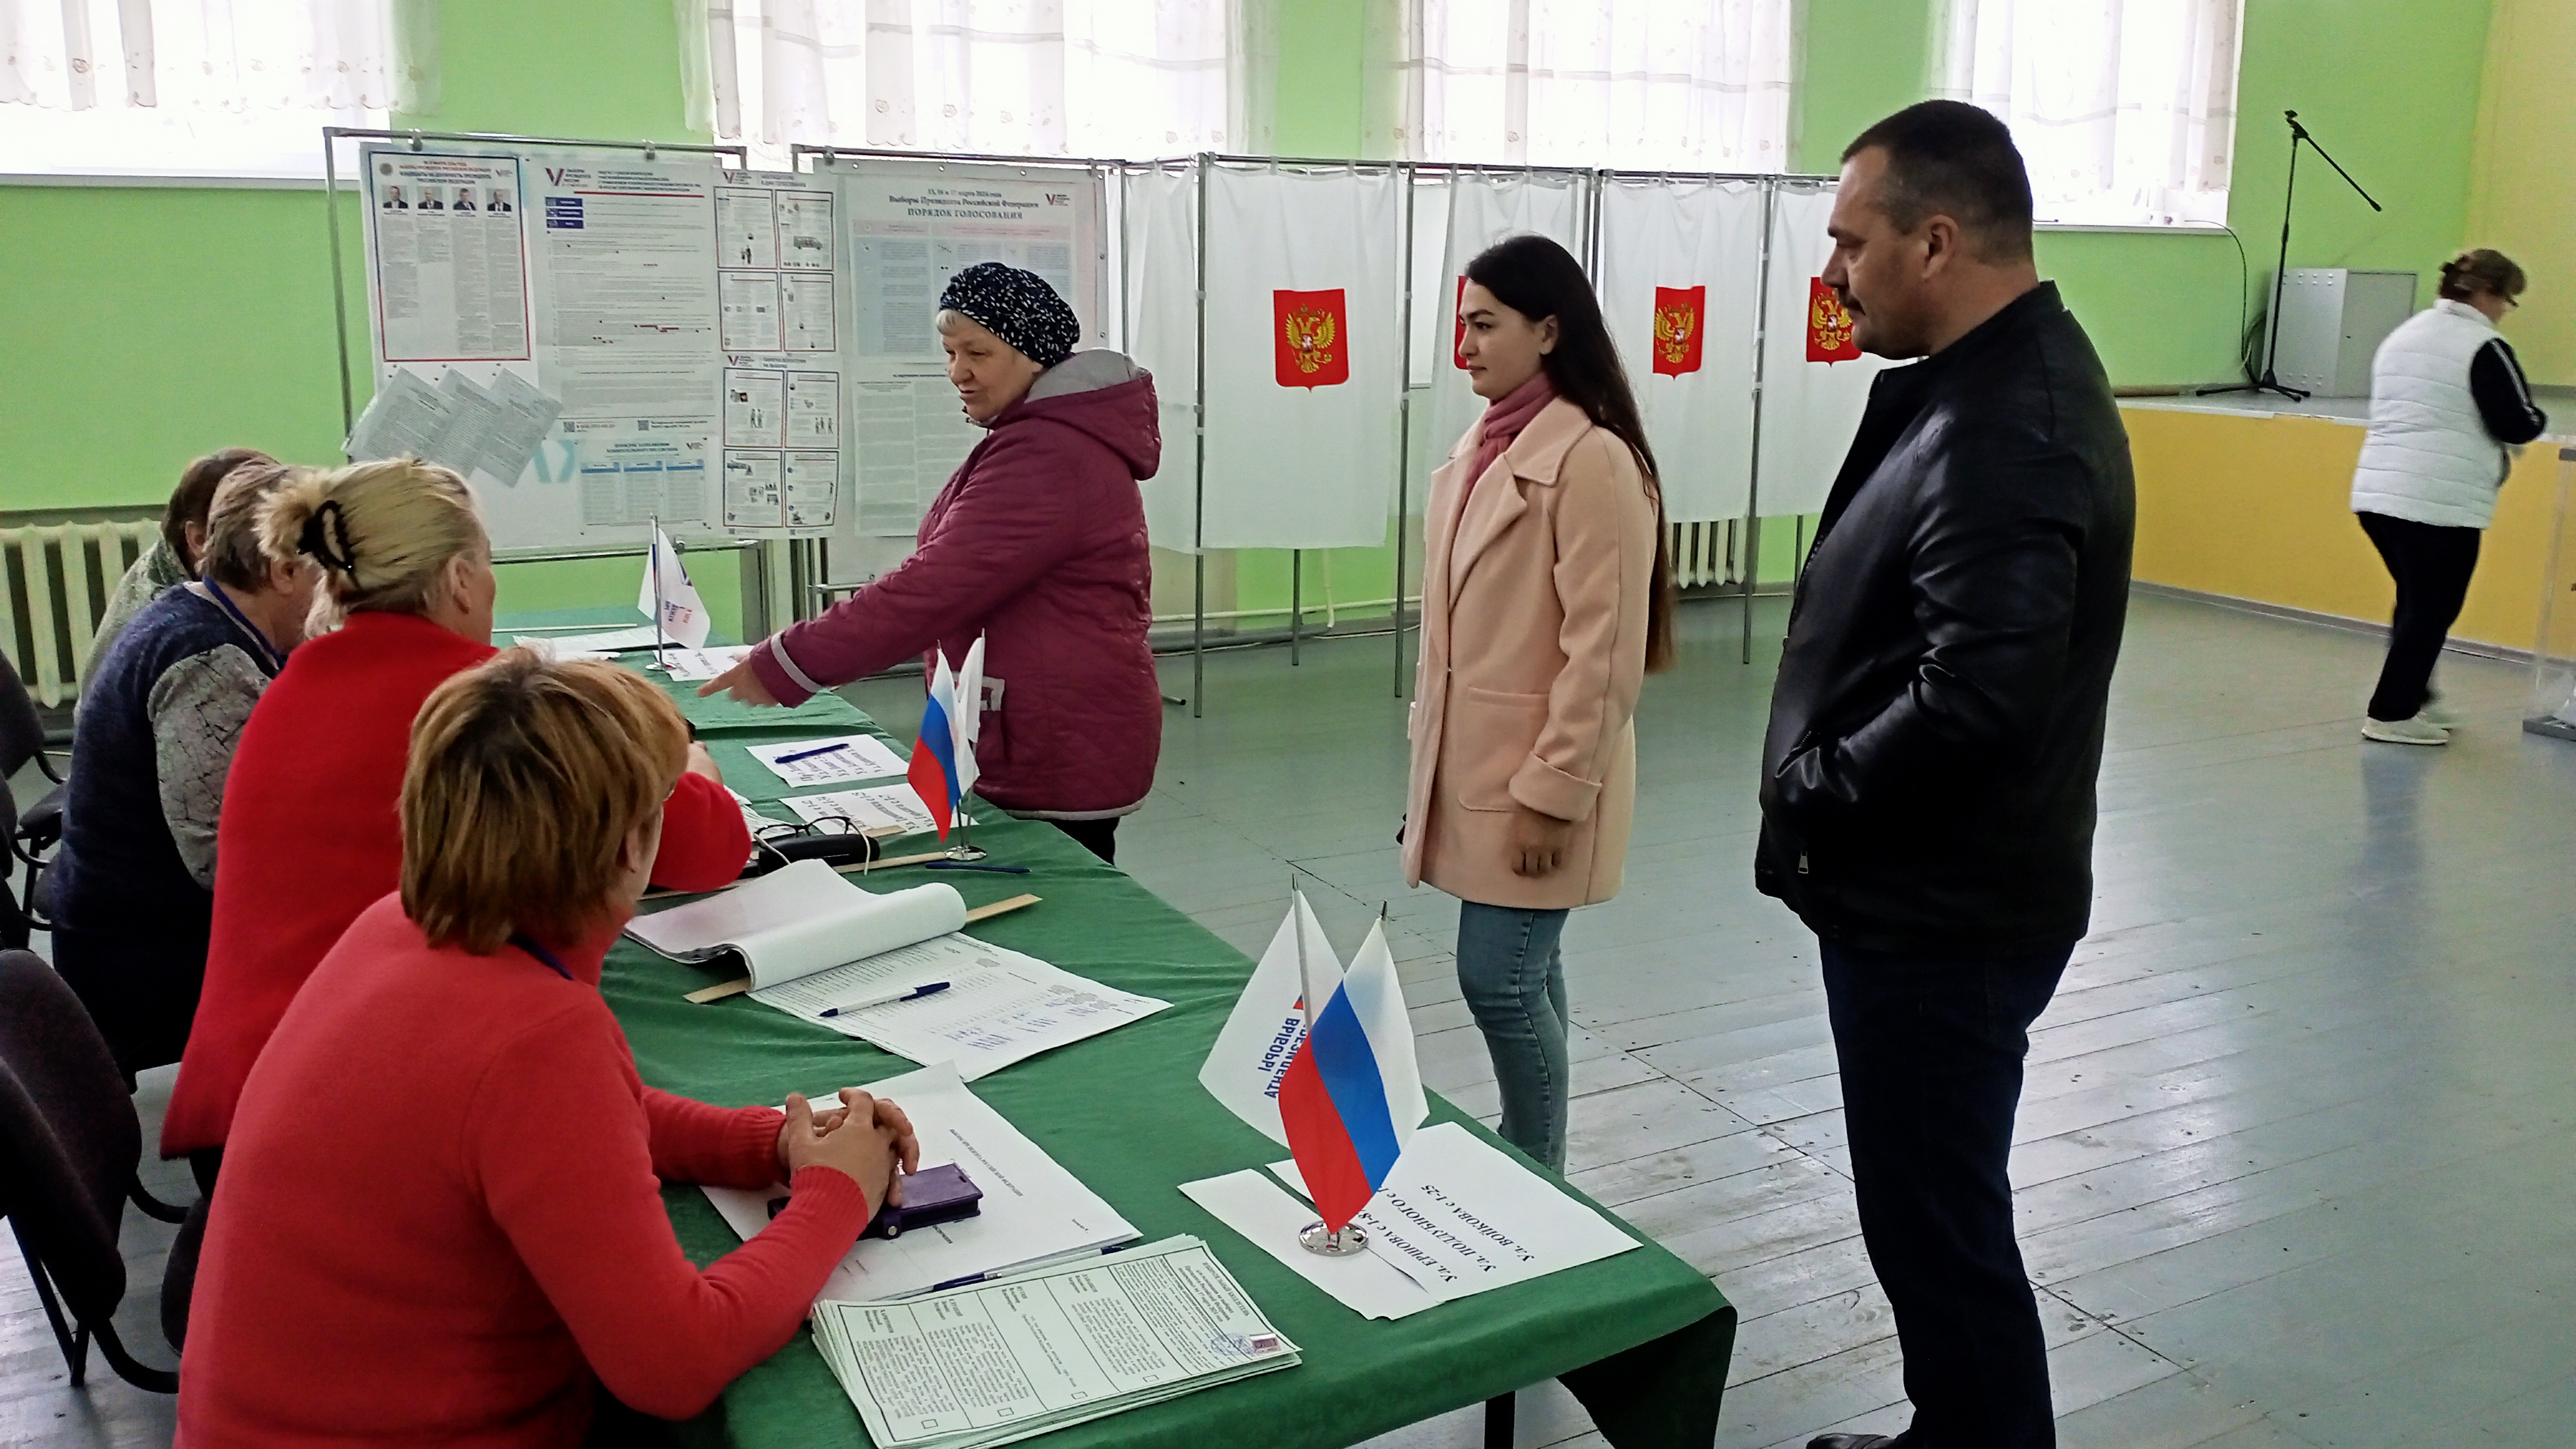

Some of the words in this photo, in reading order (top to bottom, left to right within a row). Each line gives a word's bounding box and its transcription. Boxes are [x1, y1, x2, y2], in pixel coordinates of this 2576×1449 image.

[908, 208, 952, 217] ПОРЯДОК
[955, 209, 1023, 219] ГОЛОСОВАНИЯ
[1420, 1184, 1448, 1202] 1-25
[1391, 1197, 1477, 1257] ПОДДУБНОГО
[1452, 1208, 1514, 1246] ВОЙКОВА
[1383, 1231, 1438, 1267] ЕРШОВА
[1514, 1245, 1535, 1262] Ул.
[1477, 1255, 1497, 1272] Ул.
[1438, 1265, 1458, 1283] Ул.
[1202, 1262, 1232, 1292] ИЗБИРАТЕЛЬНЫЙ
[1228, 1291, 1250, 1317] БЮЛЛЕТЕНЬ
